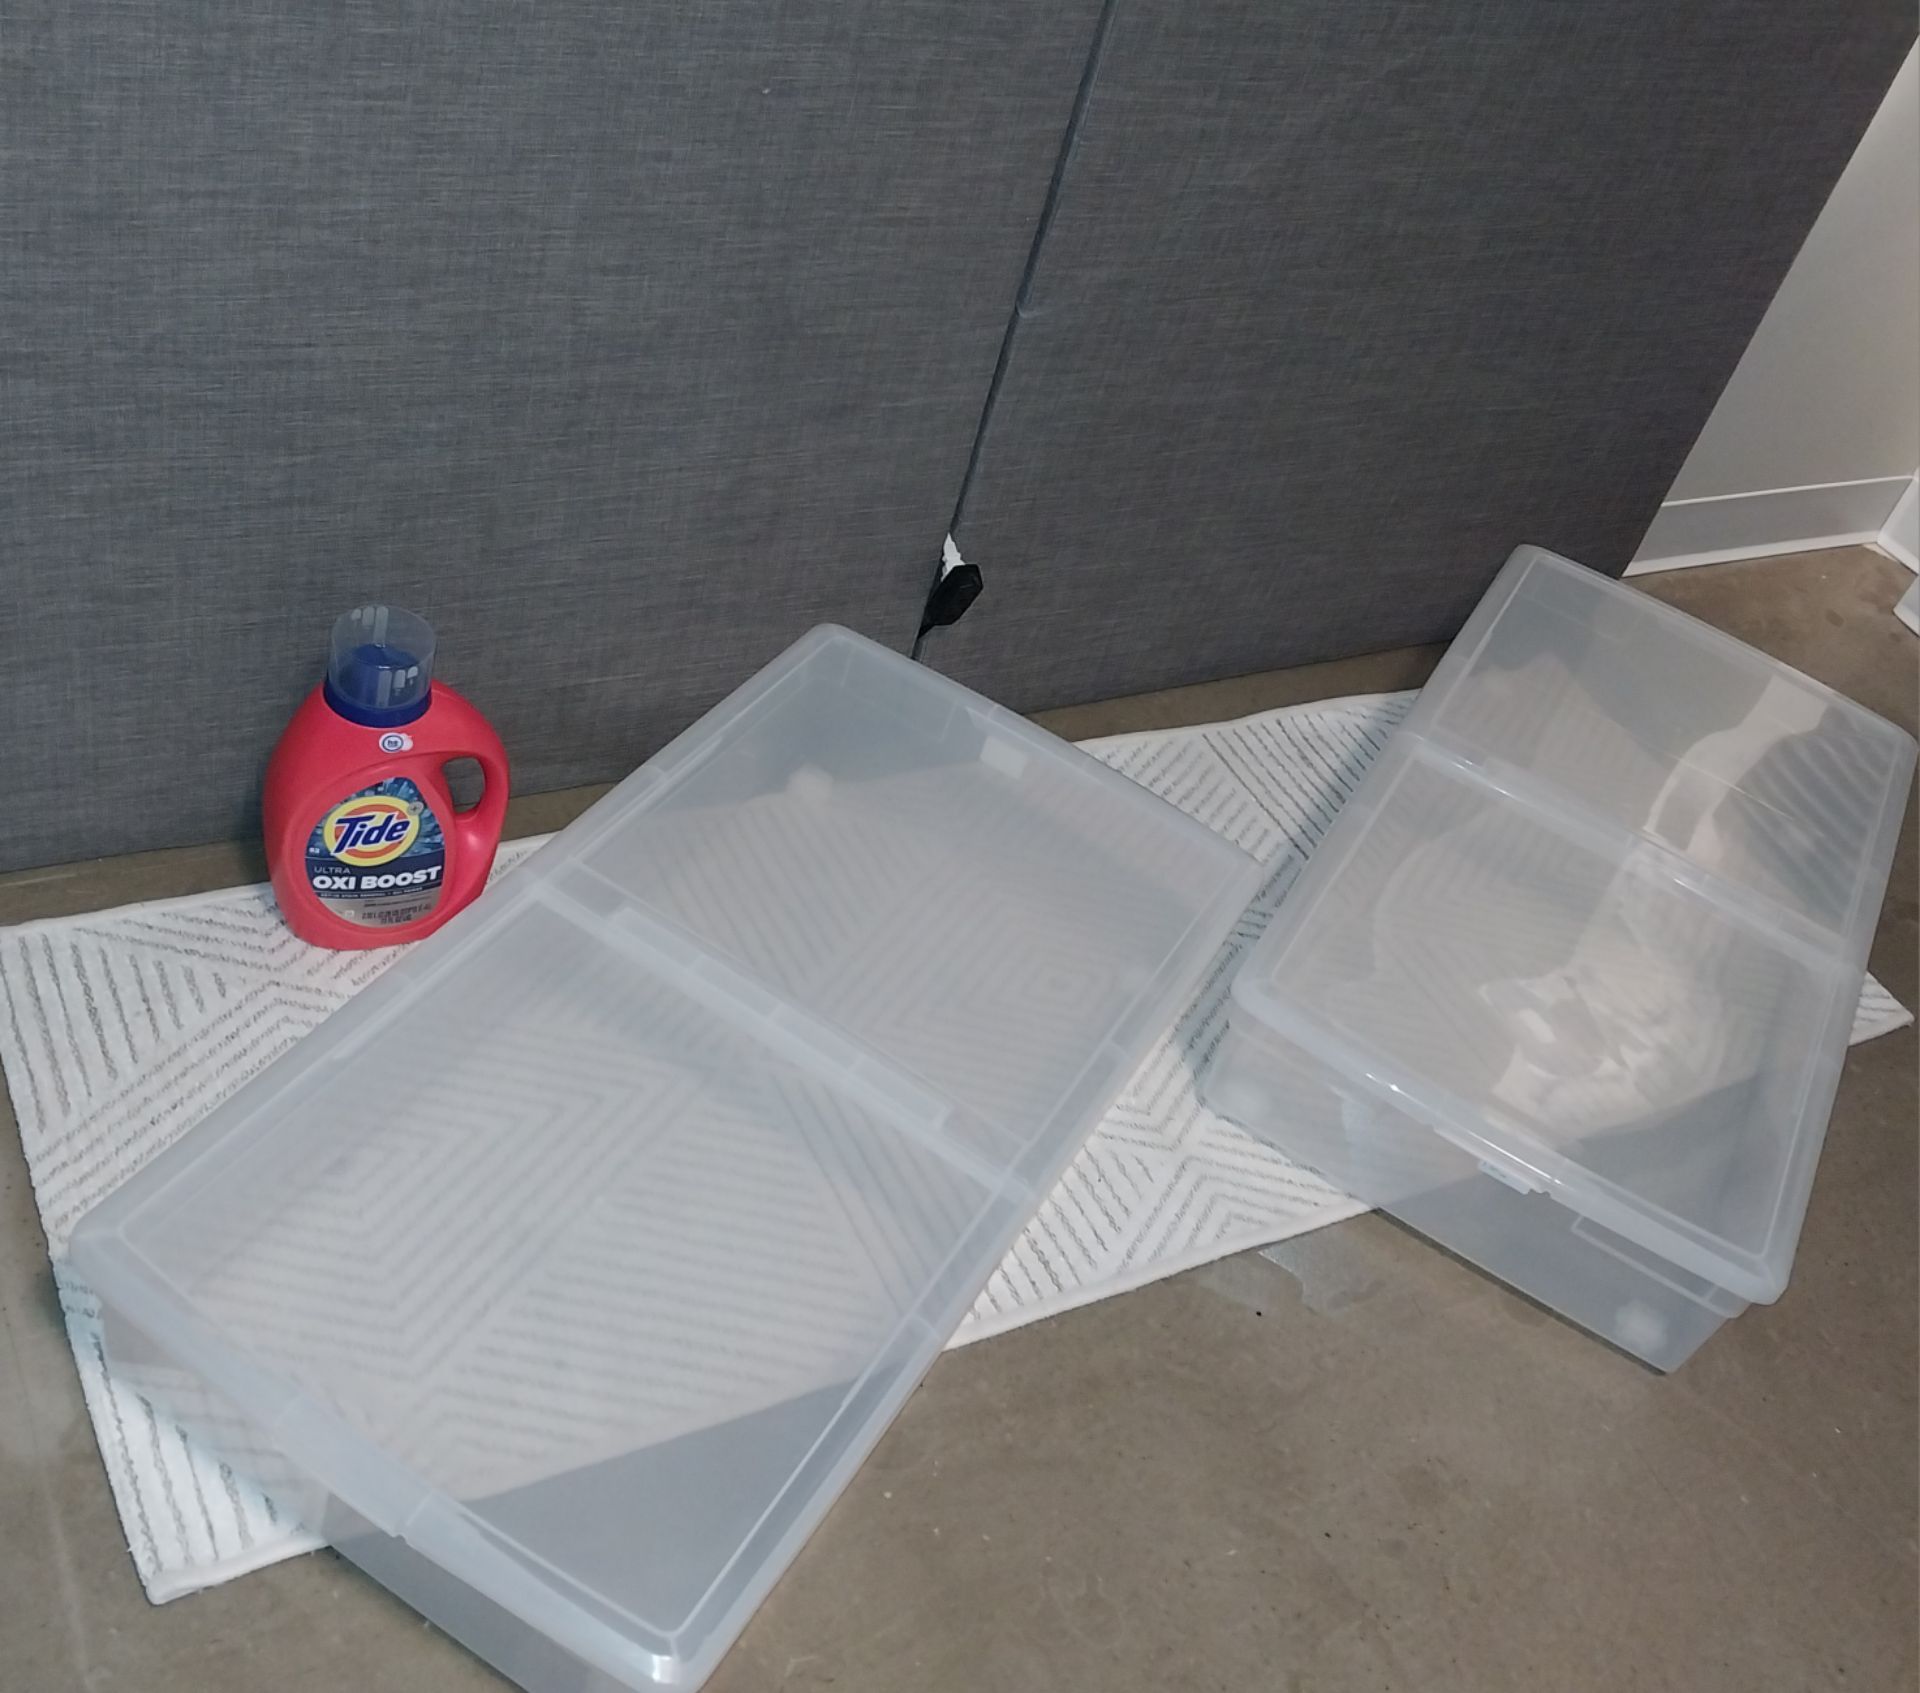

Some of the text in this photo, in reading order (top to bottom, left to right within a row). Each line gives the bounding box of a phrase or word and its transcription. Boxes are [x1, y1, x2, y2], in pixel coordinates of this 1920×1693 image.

[332, 812, 410, 854] Tide
[312, 865, 442, 890] OXI BOOST
[314, 866, 351, 875] ULTRA
